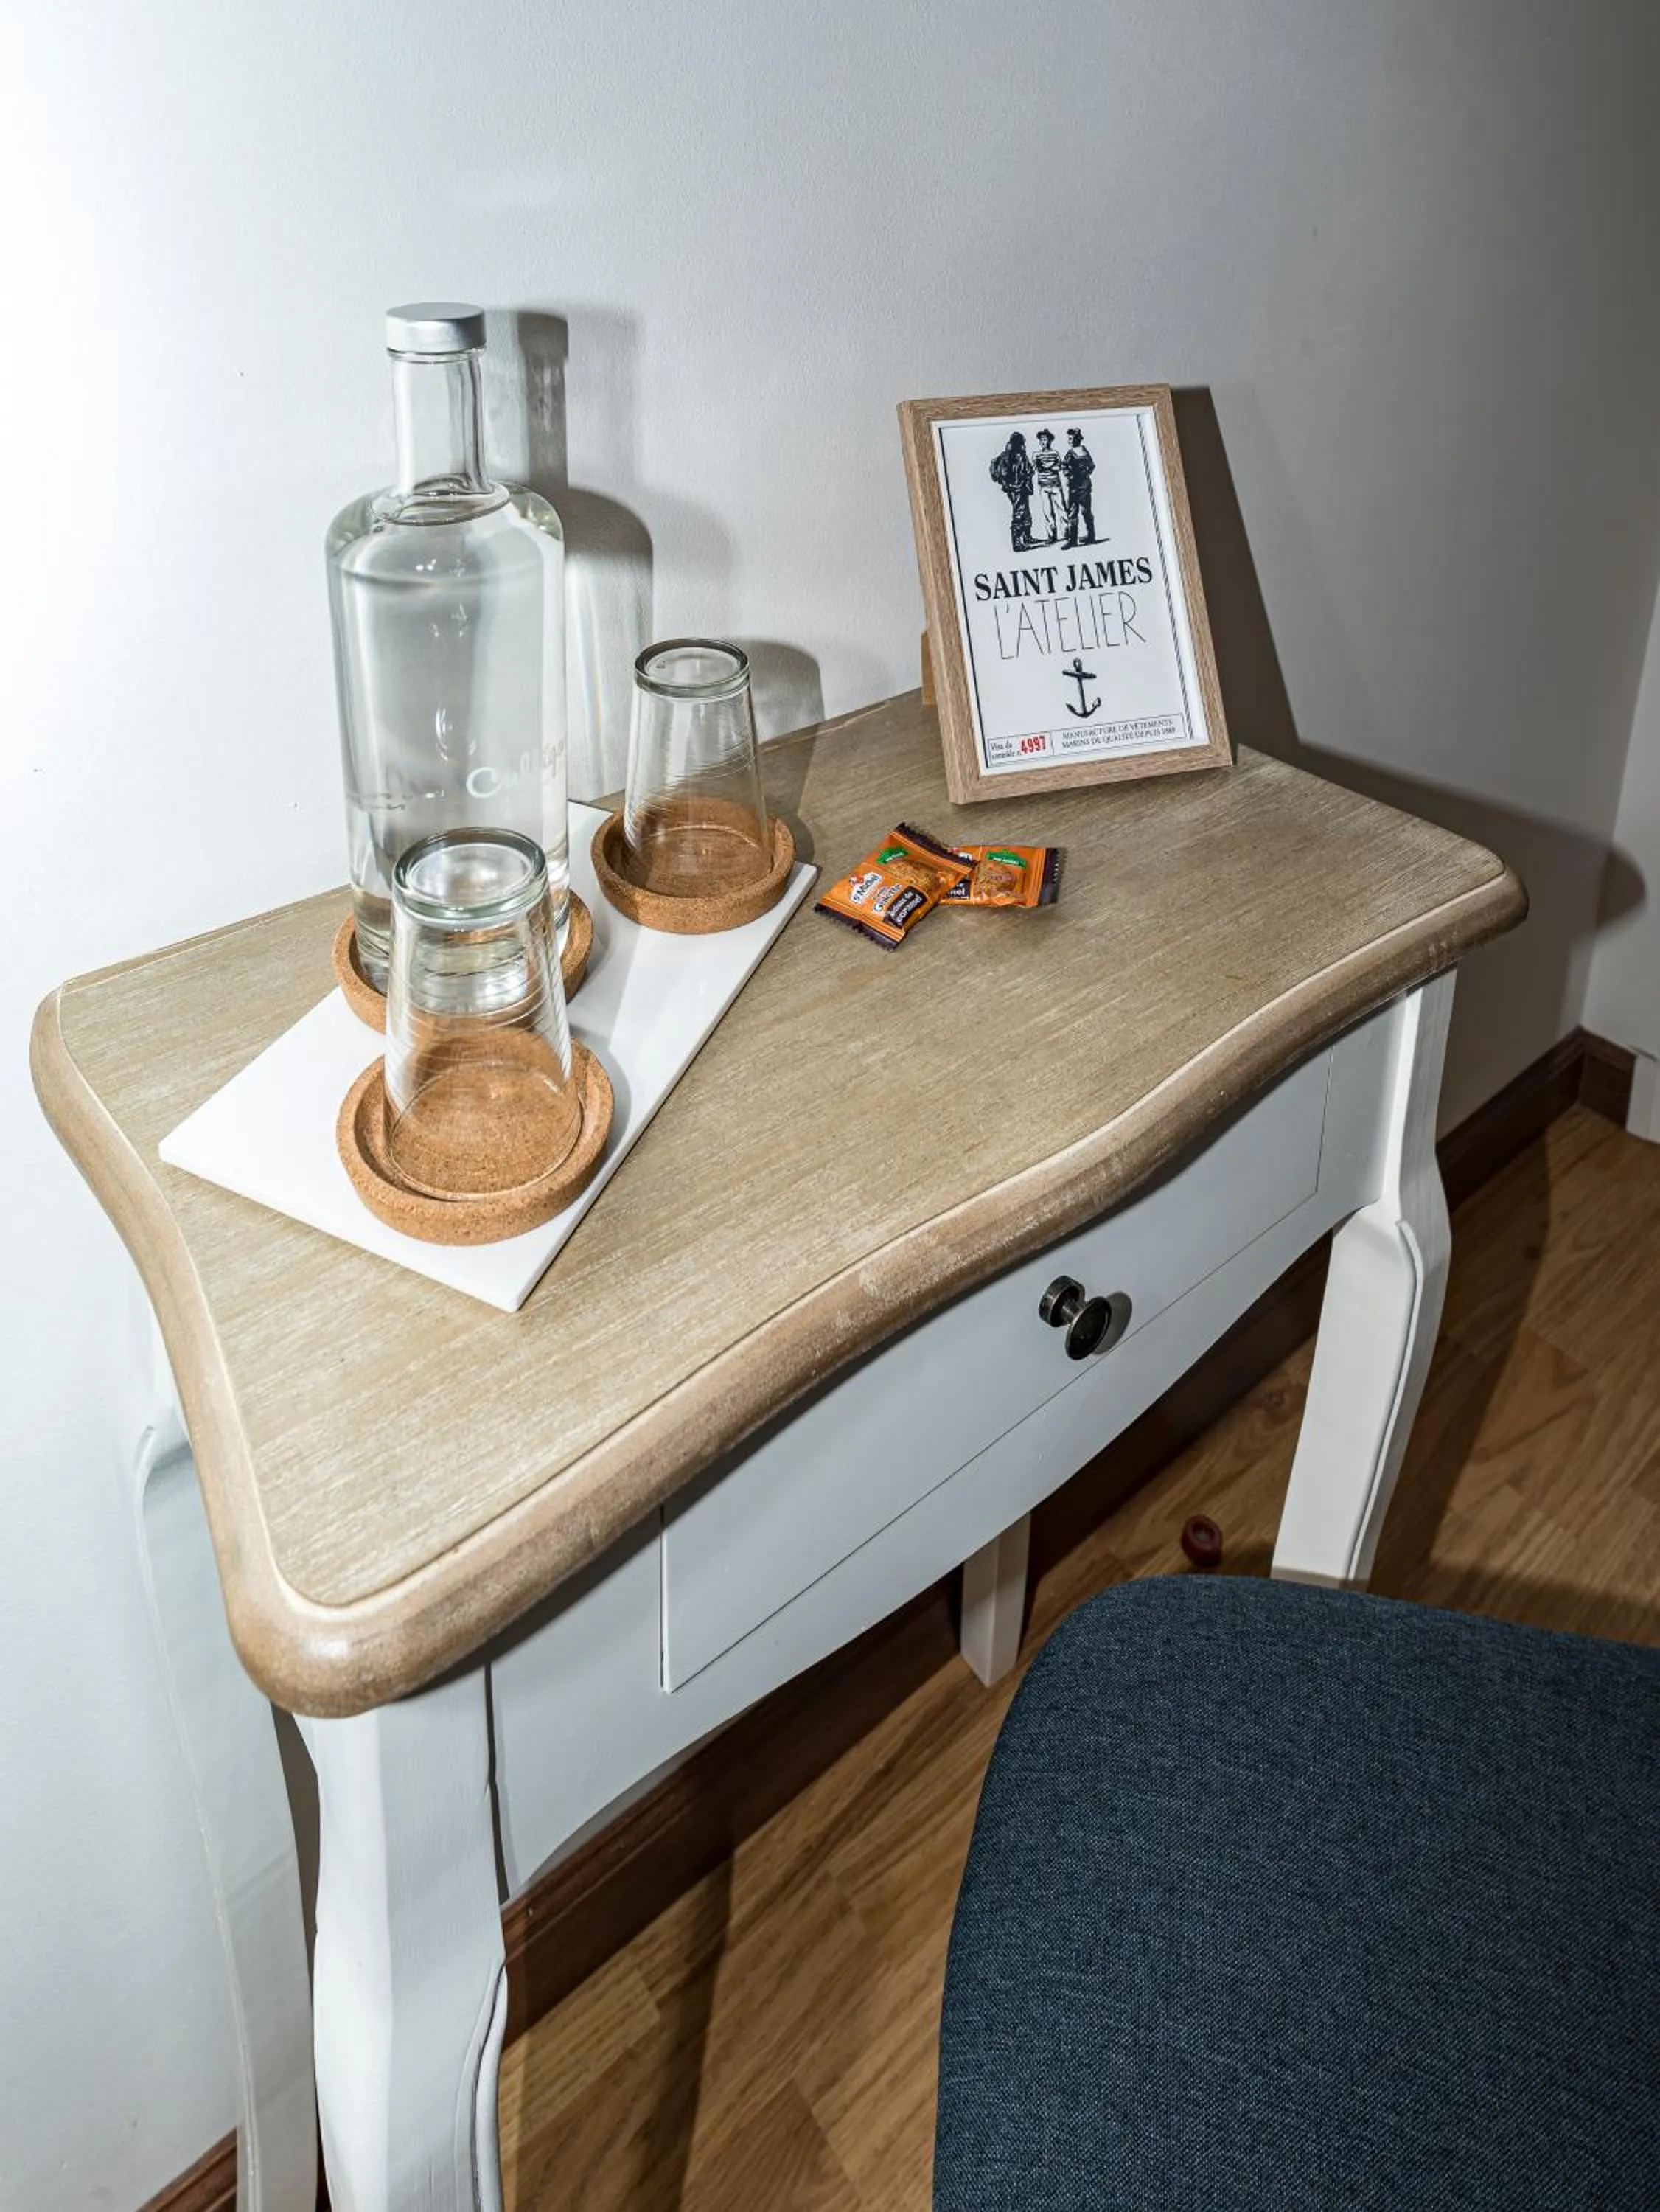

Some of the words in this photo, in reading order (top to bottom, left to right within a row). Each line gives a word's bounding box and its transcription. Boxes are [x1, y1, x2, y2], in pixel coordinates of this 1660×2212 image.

[975, 567, 1057, 601] SAINT
[1065, 557, 1153, 592] JAMES
[994, 591, 1147, 660] L'ATELIER
[1020, 735, 1047, 754] 4997
